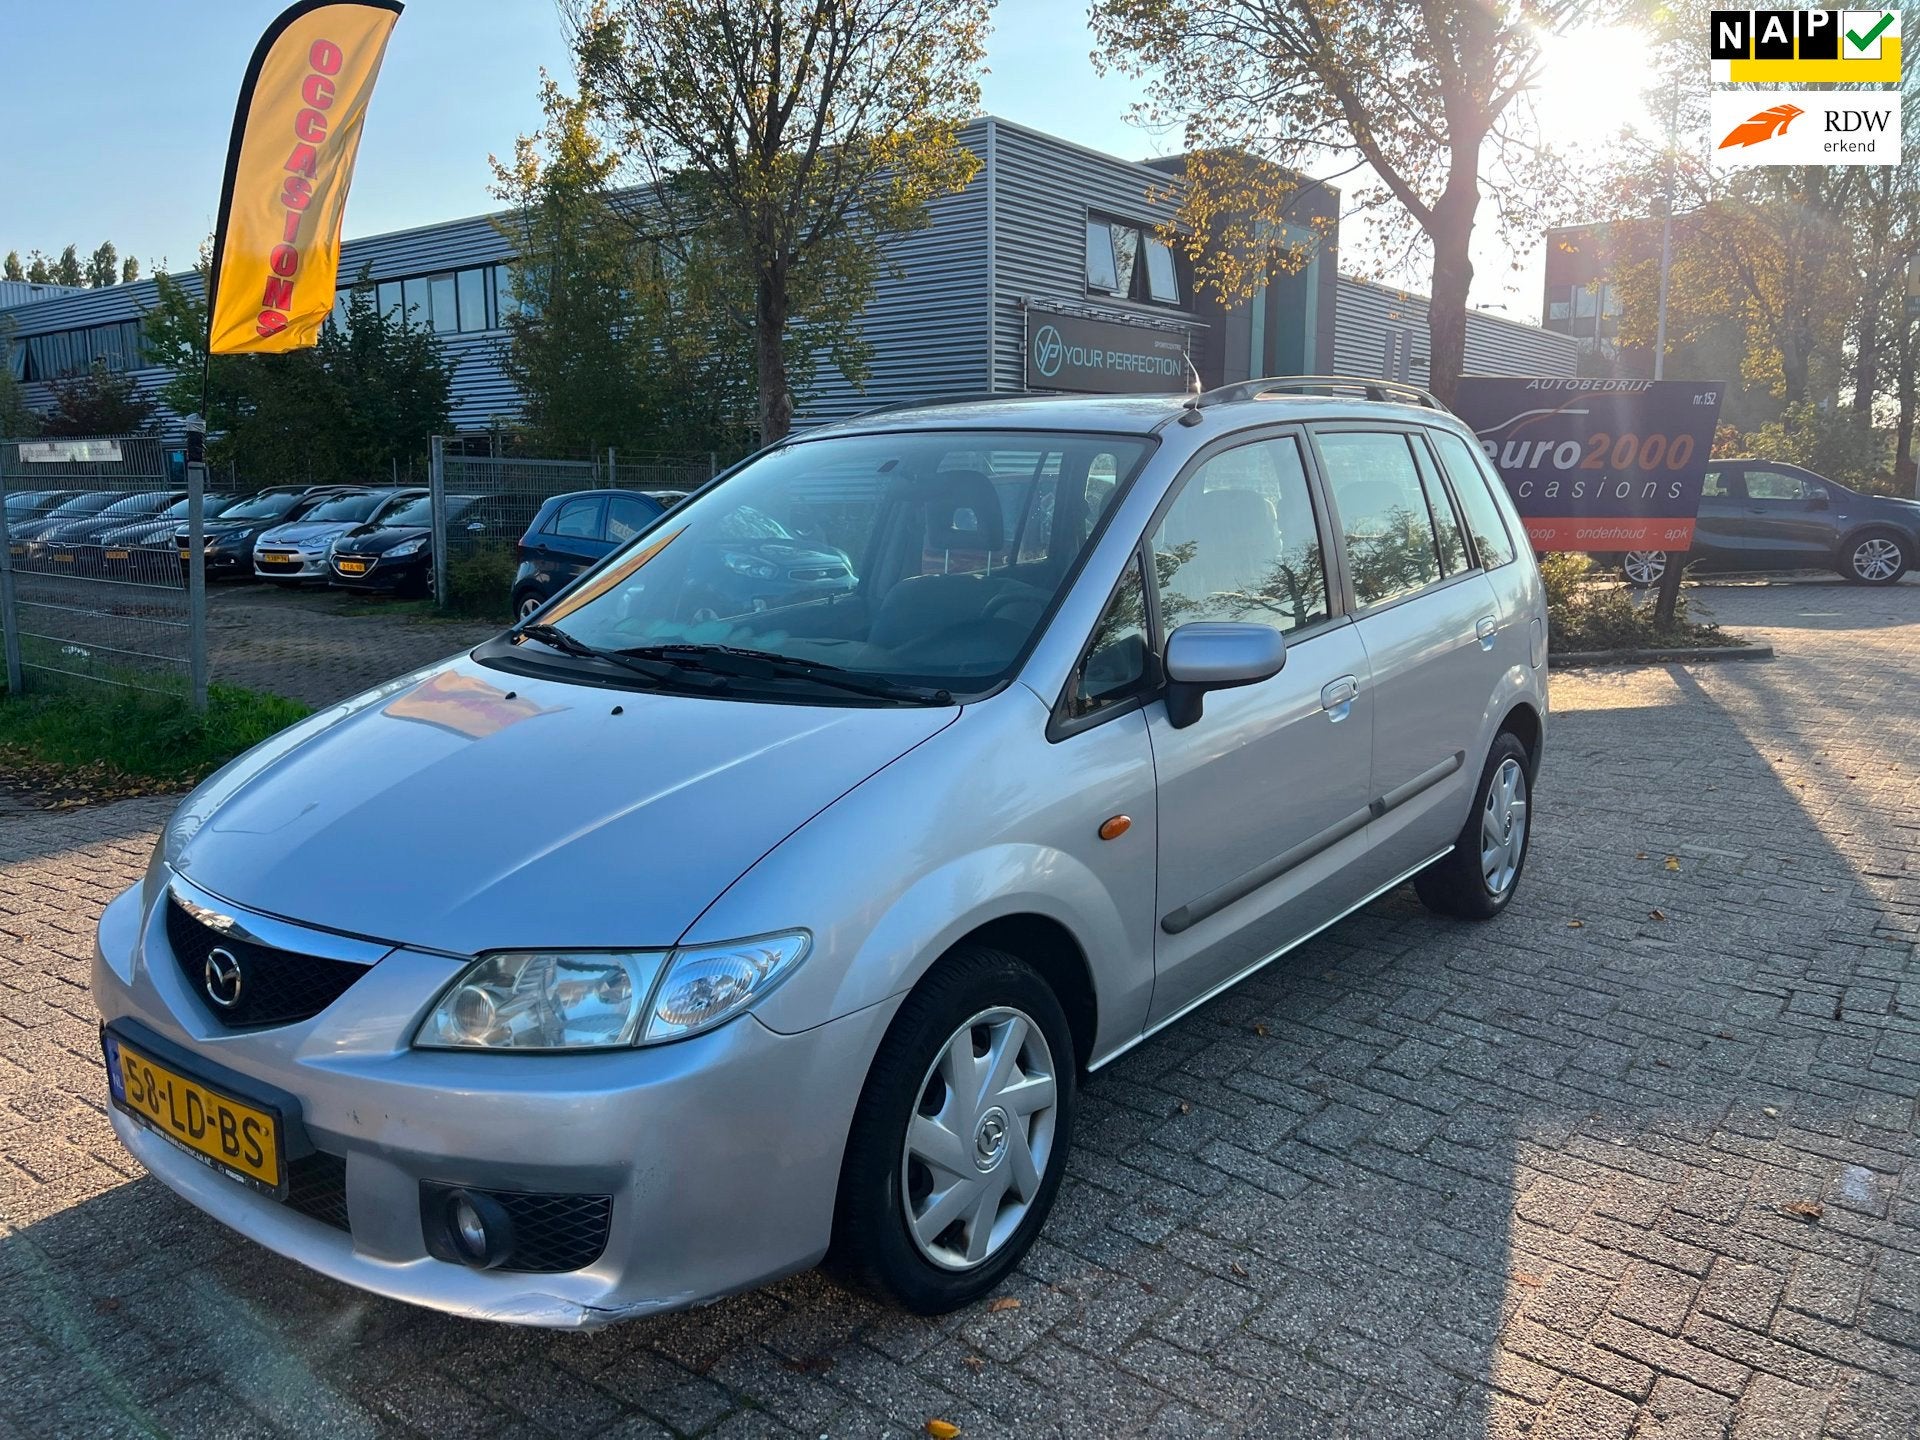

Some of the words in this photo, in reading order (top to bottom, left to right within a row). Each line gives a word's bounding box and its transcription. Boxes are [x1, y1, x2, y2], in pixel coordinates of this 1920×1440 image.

[256, 38, 343, 338] OCCASIONS
[1063, 345, 1103, 368] YOUR
[1106, 352, 1181, 376] PERFECTION
[1526, 378, 1654, 392] AUTOBEDRIJF
[1692, 392, 1717, 406] nr.152
[1519, 476, 1682, 499] casions
[1576, 525, 1645, 540] onderhoud
[1664, 526, 1688, 541] apk
[112, 1073, 124, 1089] NL
[125, 1055, 263, 1169] 58-LD-BS
